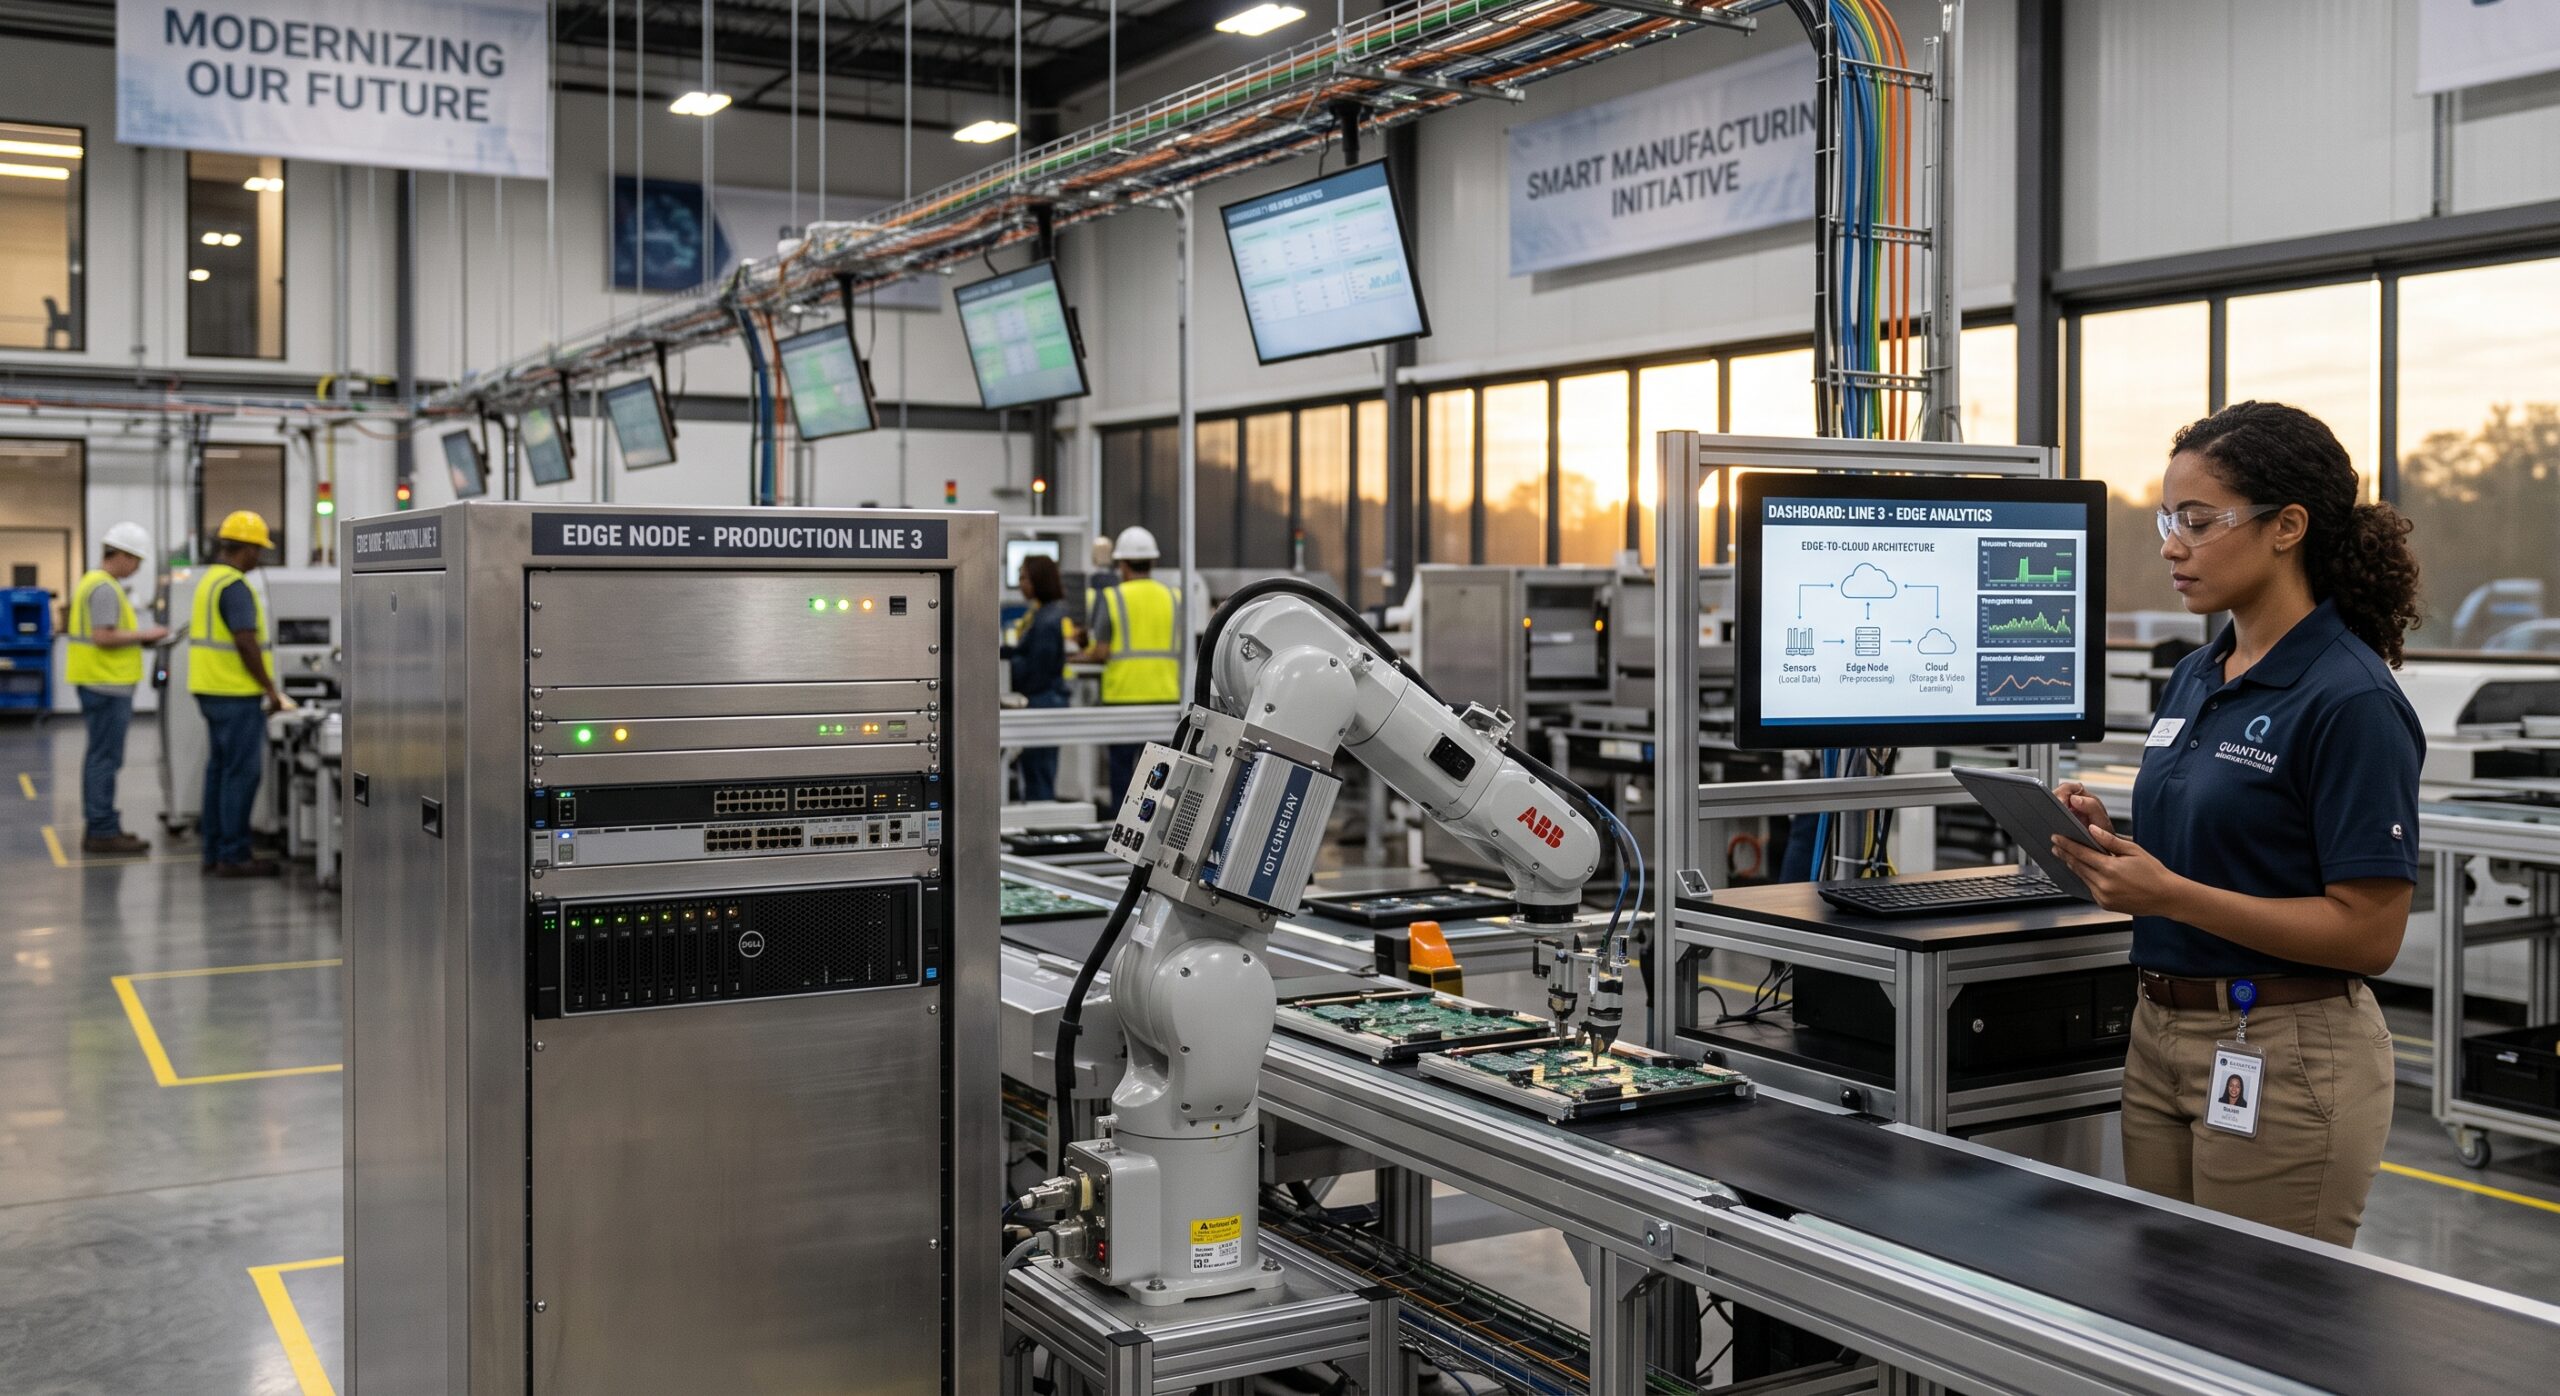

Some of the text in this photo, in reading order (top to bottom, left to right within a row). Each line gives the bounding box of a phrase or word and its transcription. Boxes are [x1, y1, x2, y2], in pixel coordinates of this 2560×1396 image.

[164, 8, 505, 79] MODERNIZING
[187, 60, 489, 123] OUR FUTURE
[1527, 99, 1816, 200] SMART MANUFACTURIN
[1612, 160, 1740, 217] INITIATIVE
[1768, 505, 1846, 520] DASHBOARD:
[1848, 506, 1875, 520] LINE
[1877, 507, 1886, 521] 3
[1896, 507, 1927, 521] EDGE
[1929, 508, 1993, 522] ANALYTICS
[562, 524, 622, 547] EDGE
[629, 524, 690, 548] NODE
[714, 526, 853, 549] PRODUCTION
[859, 528, 905, 550] LINE
[910, 529, 923, 550] 3
[1801, 541, 1935, 552] EDGE-TO-CLOUD ARCHITECTURE
[1783, 663, 1817, 672] Sensors
[1846, 663, 1889, 673] Edge Node
[1925, 662, 1949, 671] Cloud
[1778, 675, 1821, 684] (Local Data)
[1516, 806, 1565, 848] ABB
